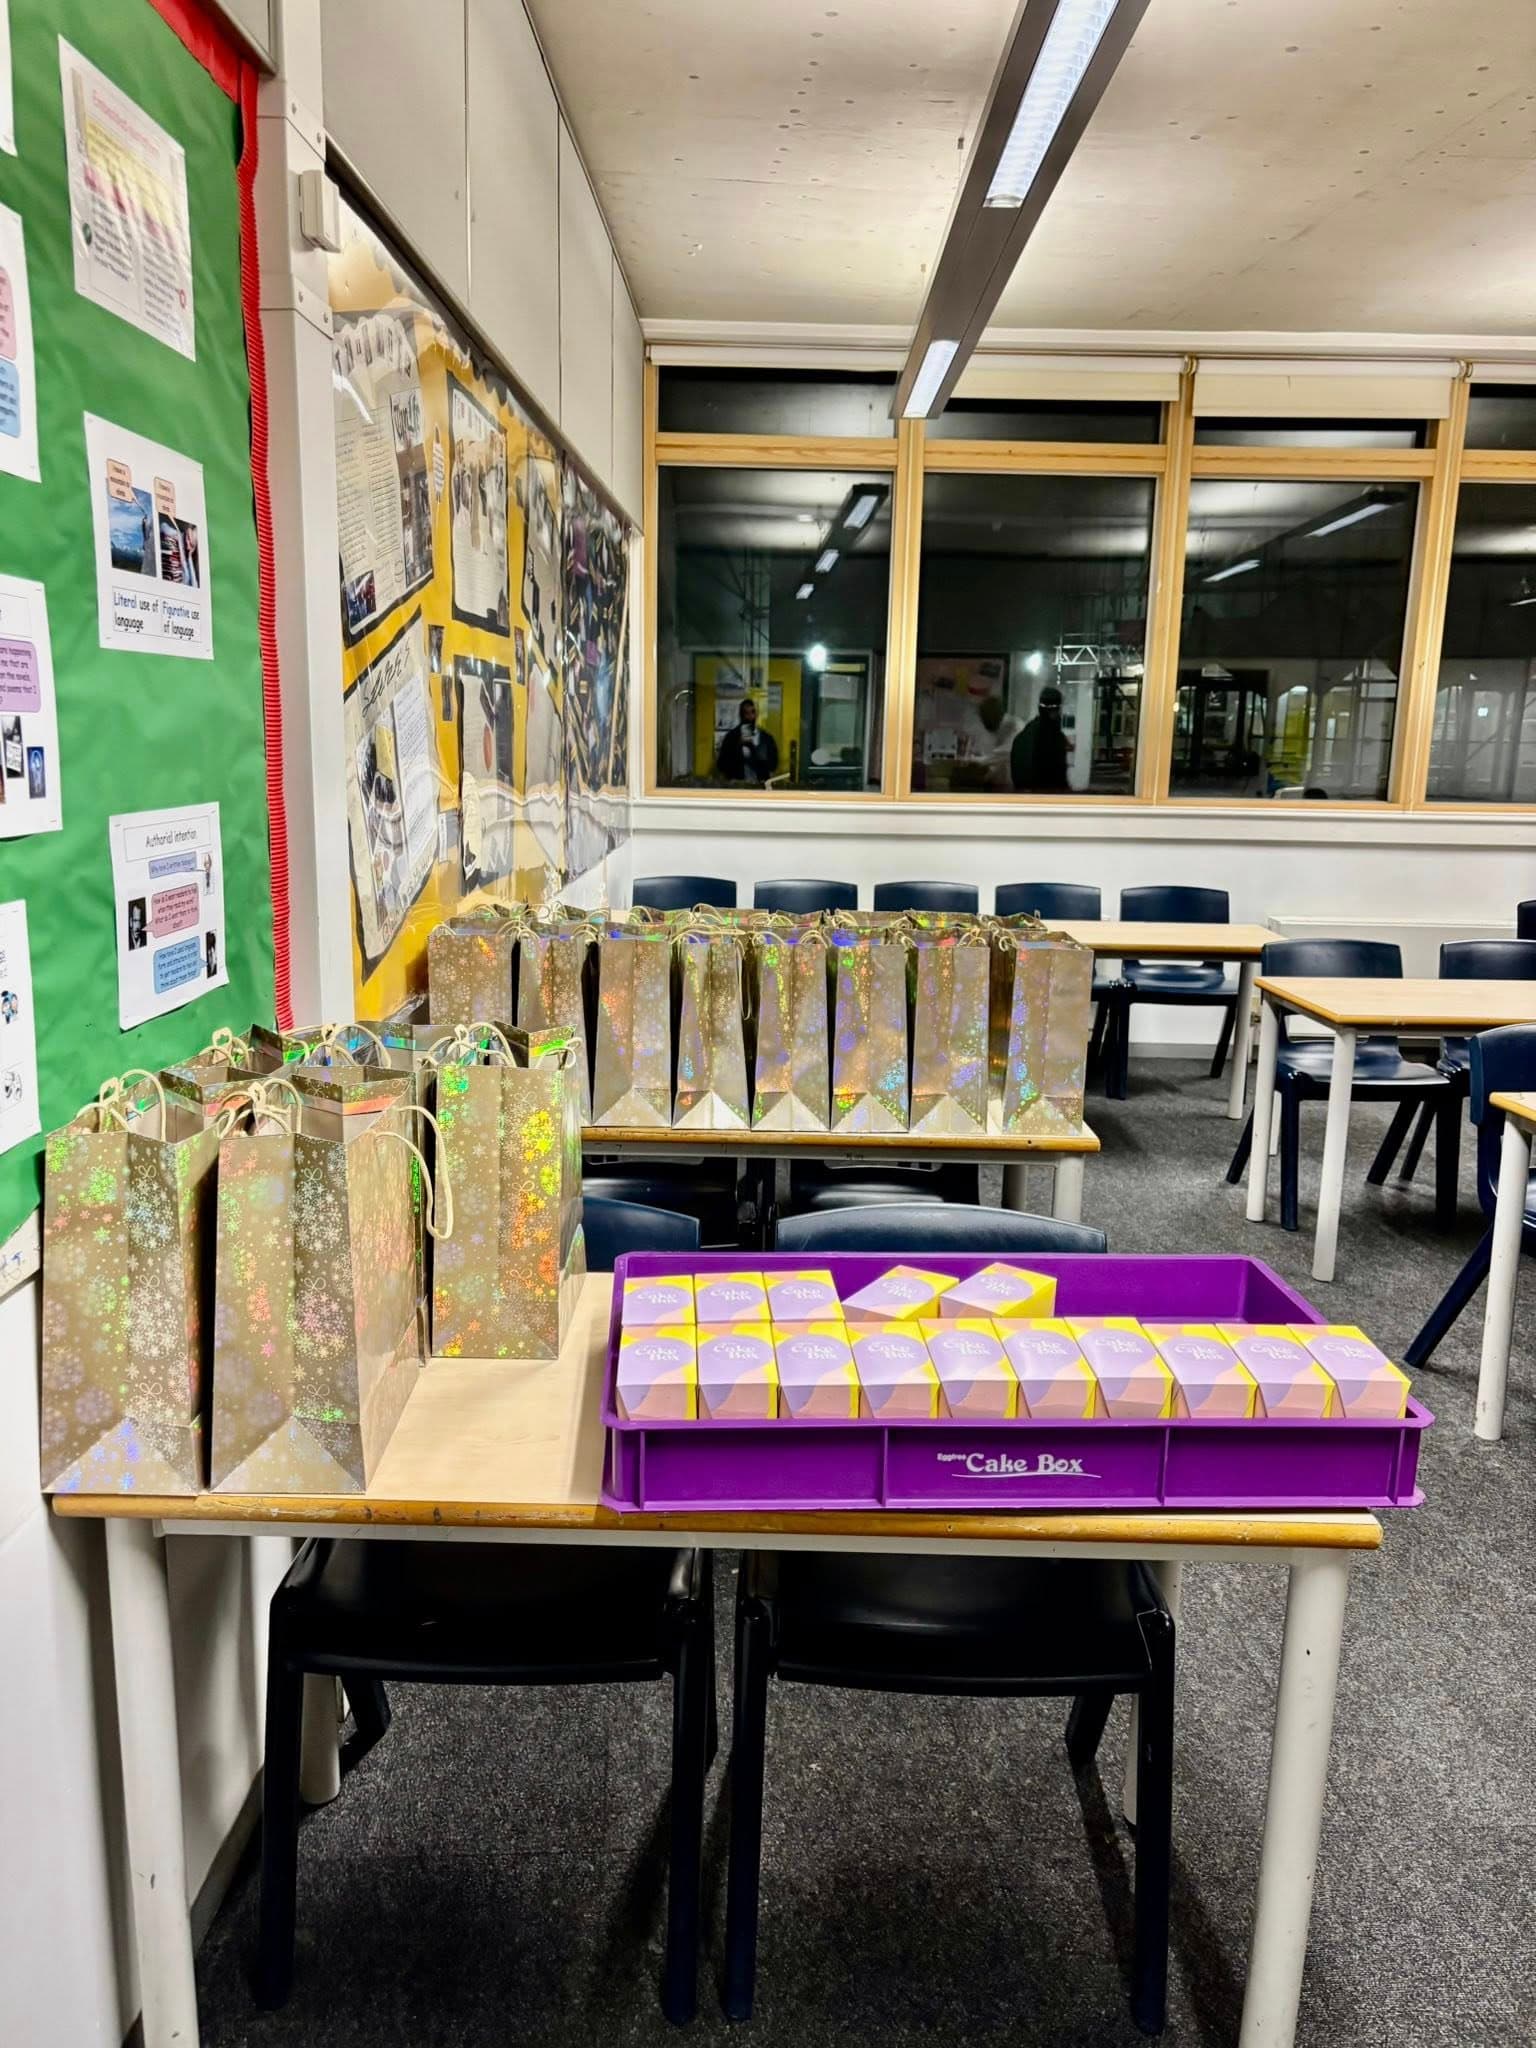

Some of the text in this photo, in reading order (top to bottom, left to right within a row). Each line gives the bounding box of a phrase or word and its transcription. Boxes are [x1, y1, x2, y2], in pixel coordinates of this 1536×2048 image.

[113, 592, 159, 613] Literal use of
[163, 601, 200, 621] Figurative use
[114, 612, 144, 633] language
[164, 620, 195, 641] of language
[145, 829, 197, 848] Authorial intention
[966, 1453, 1028, 1473] Cake
[1037, 1453, 1084, 1473] Box
